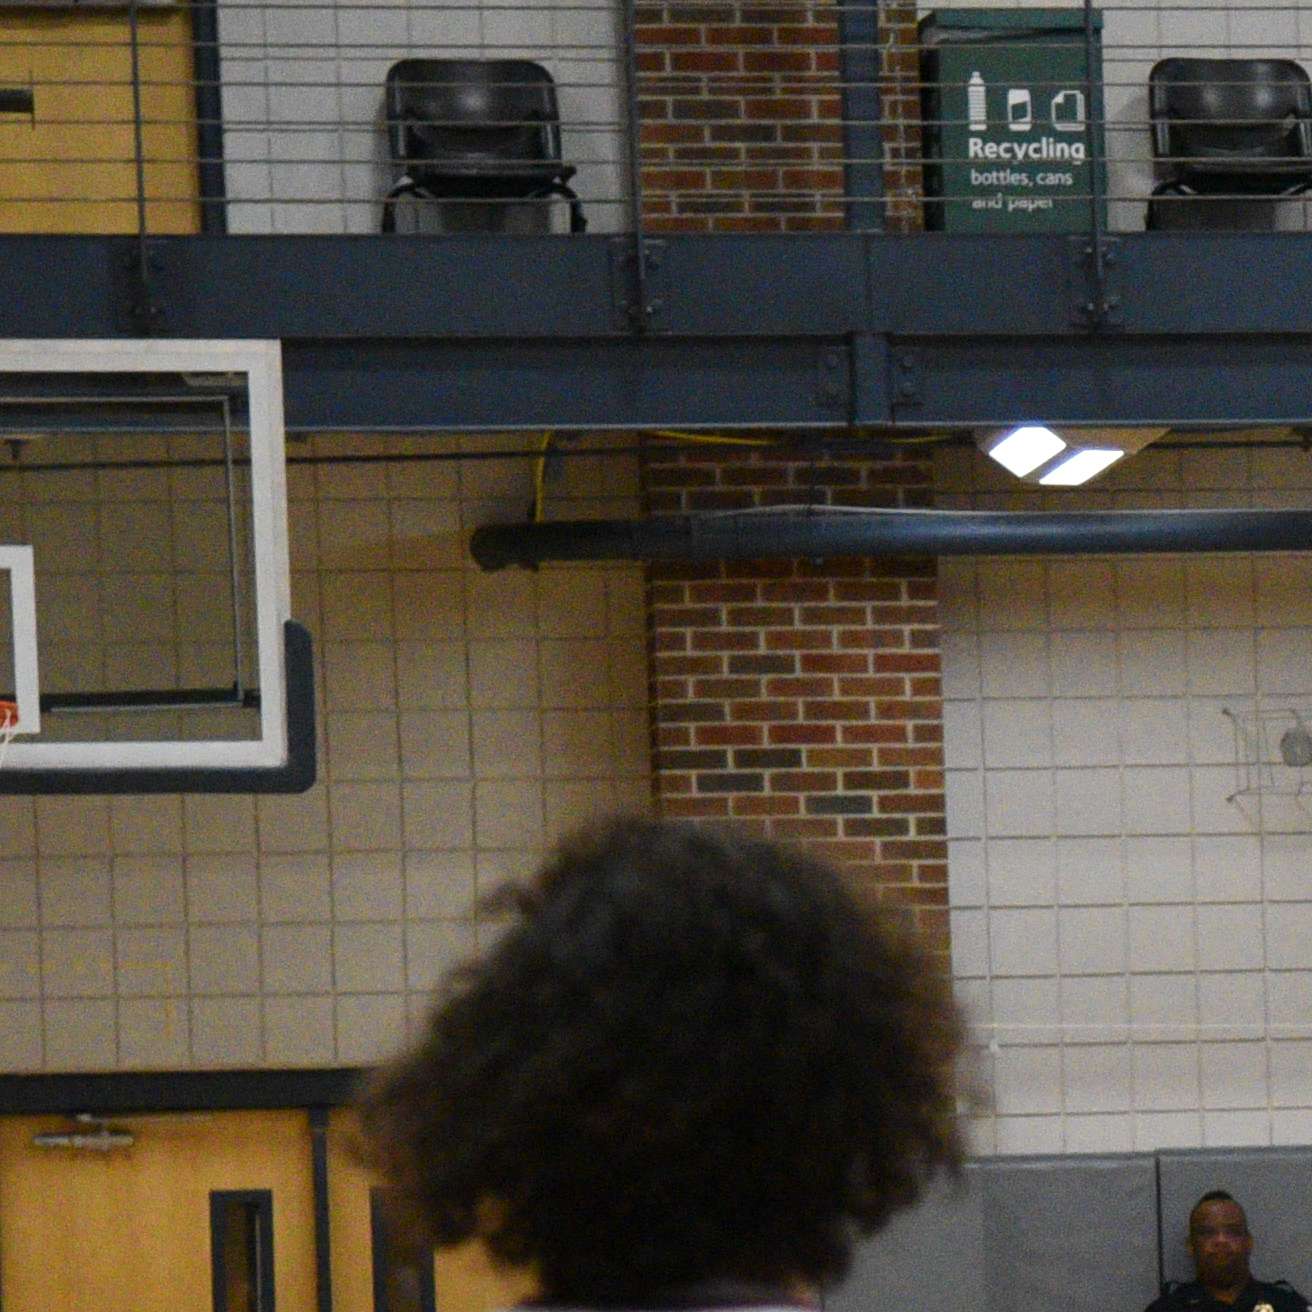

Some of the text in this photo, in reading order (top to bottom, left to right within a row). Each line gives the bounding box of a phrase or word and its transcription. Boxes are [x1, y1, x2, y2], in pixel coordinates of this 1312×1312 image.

[968, 137, 1086, 165] Recycling
[971, 168, 1073, 187] bottles, cans
[971, 192, 1053, 212] and paper
